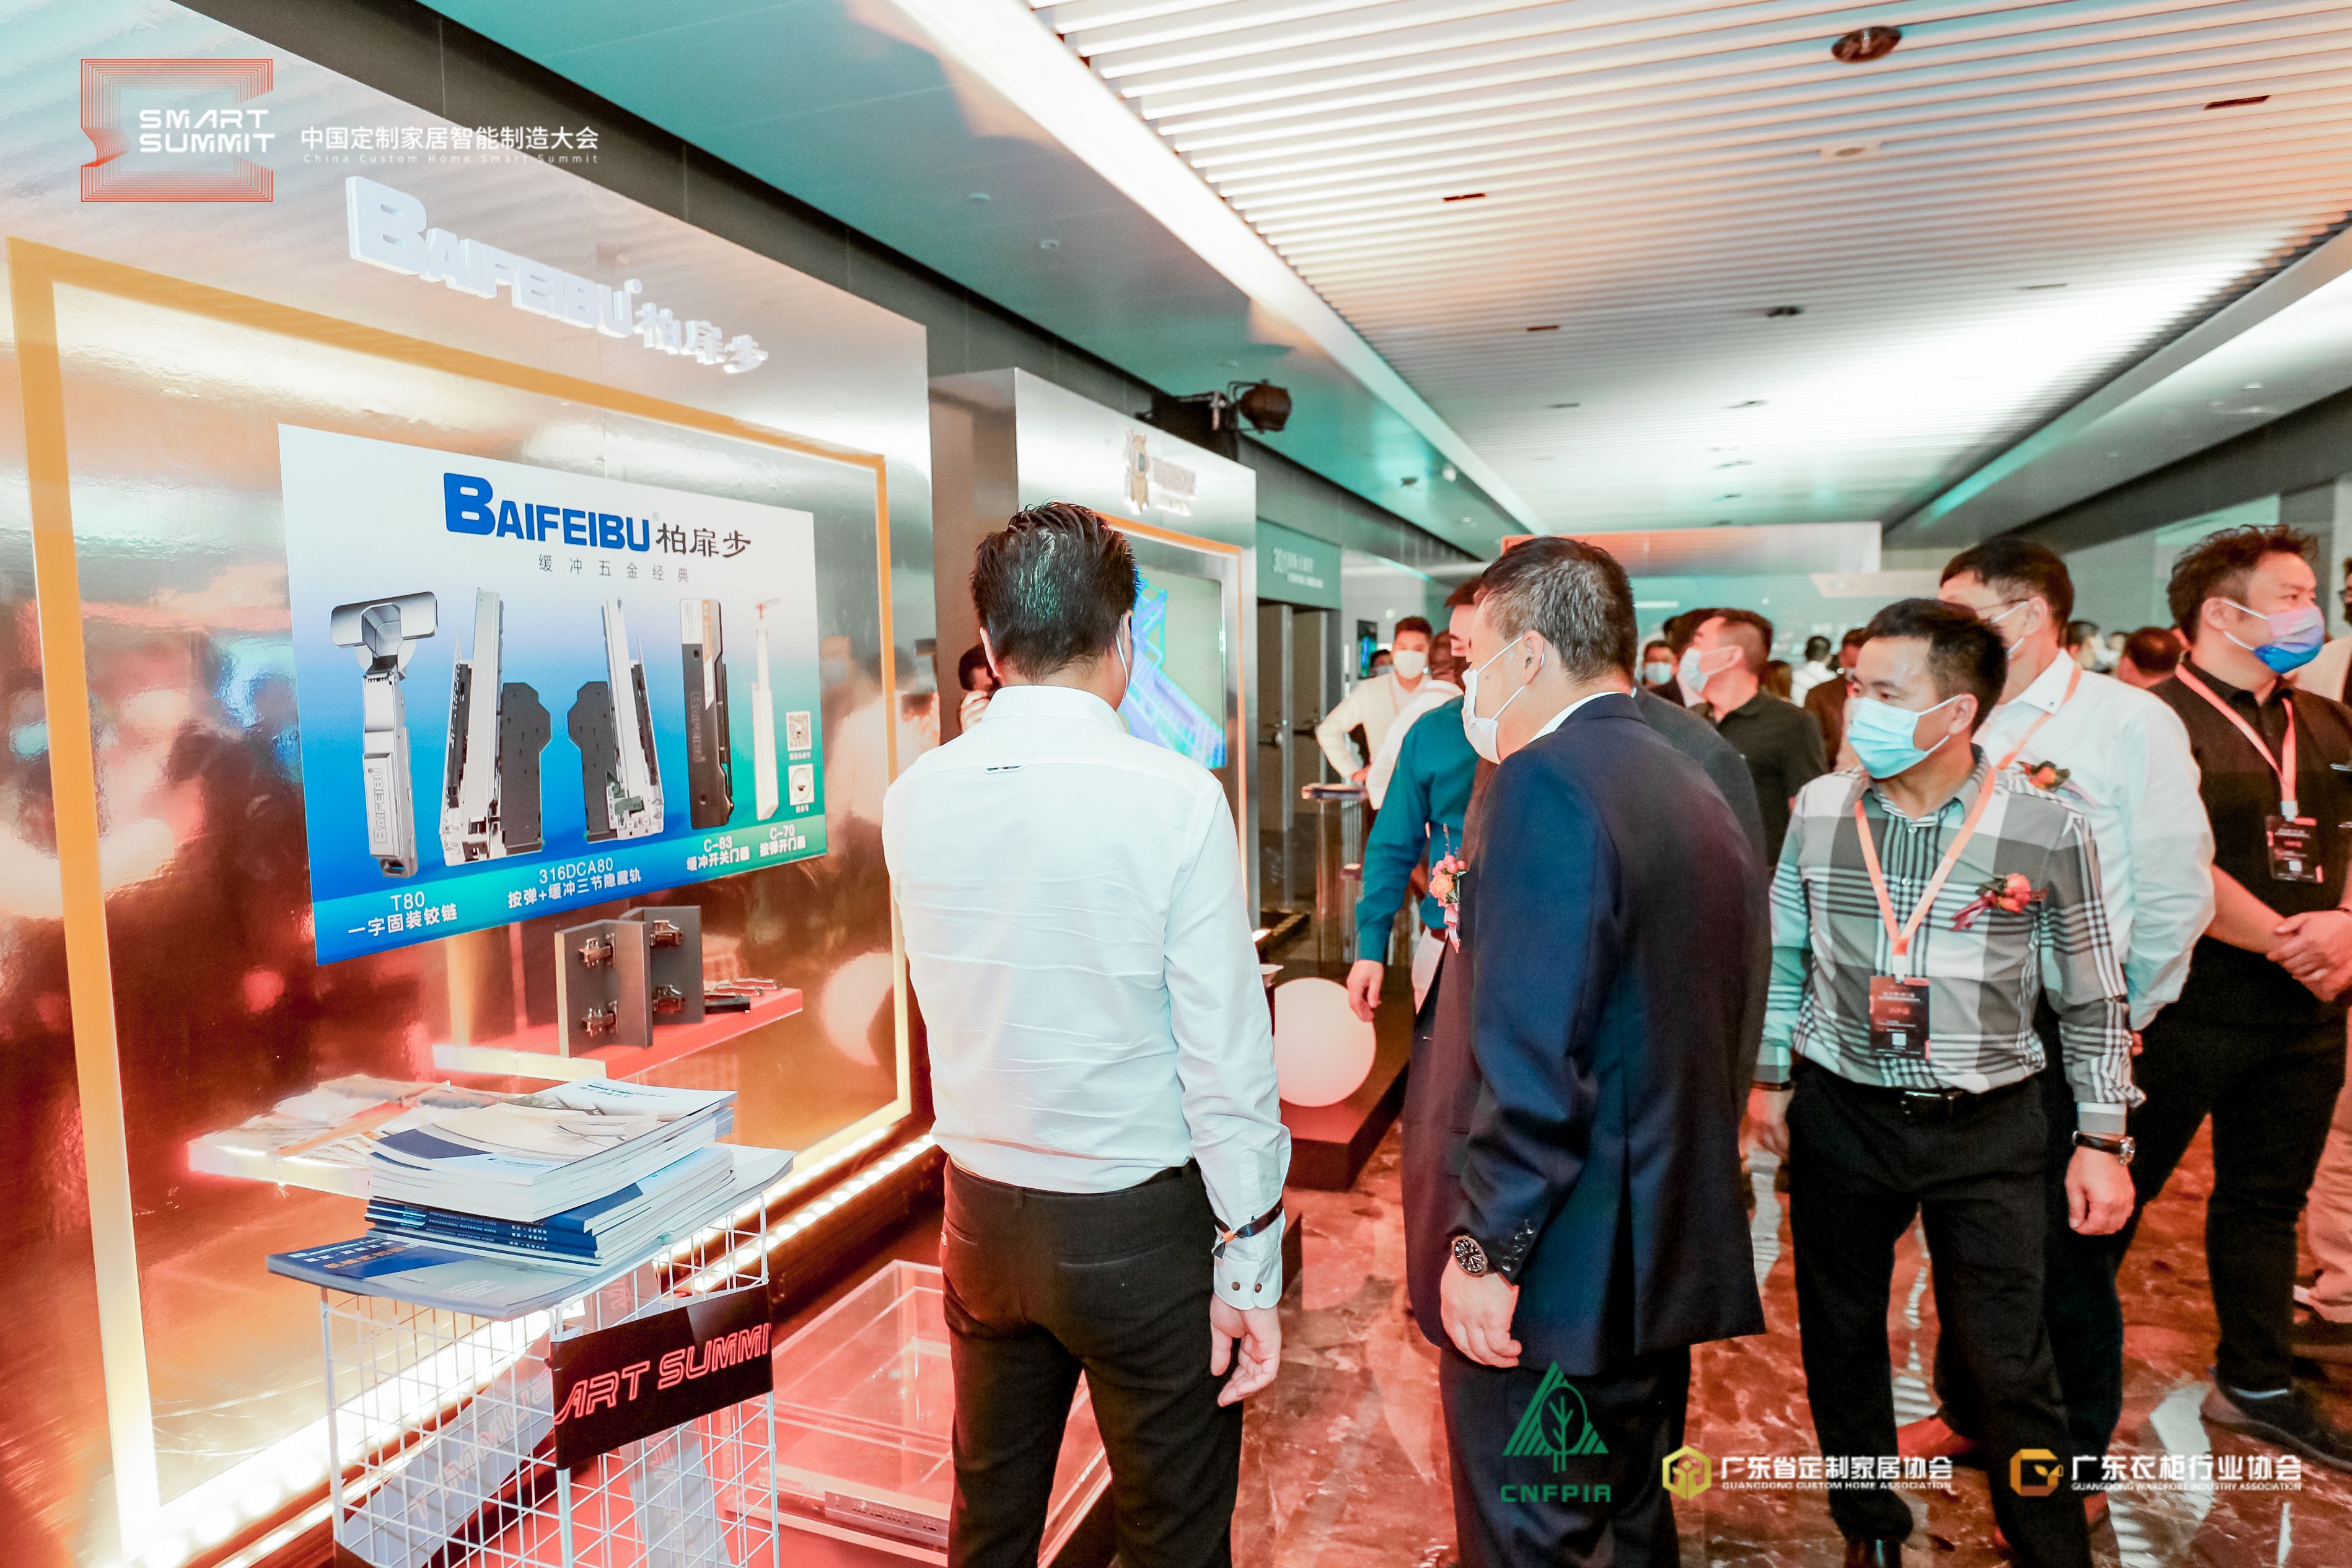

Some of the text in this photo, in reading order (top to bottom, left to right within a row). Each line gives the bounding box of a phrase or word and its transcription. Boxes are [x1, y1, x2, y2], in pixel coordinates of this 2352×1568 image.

[345, 175, 633, 338] BAIFEIBU
[443, 472, 650, 552] BAIFEIBU
[656, 523, 752, 558] 柏扉步
[538, 553, 690, 582] 缓冲五金经典
[372, 768, 387, 844] BAIFEIBU
[704, 836, 732, 852] C-83
[760, 835, 806, 857] 按弹开门器
[770, 824, 796, 839] C-70
[539, 857, 613, 884] 316DCA80
[686, 846, 750, 871] 缓冲开关门器
[390, 891, 426, 911] T80
[507, 867, 641, 909] 按弹+缓冲三节隐藏轨
[348, 903, 459, 937] 一字固装铰链
[657, 1322, 772, 1390] SUMMI
